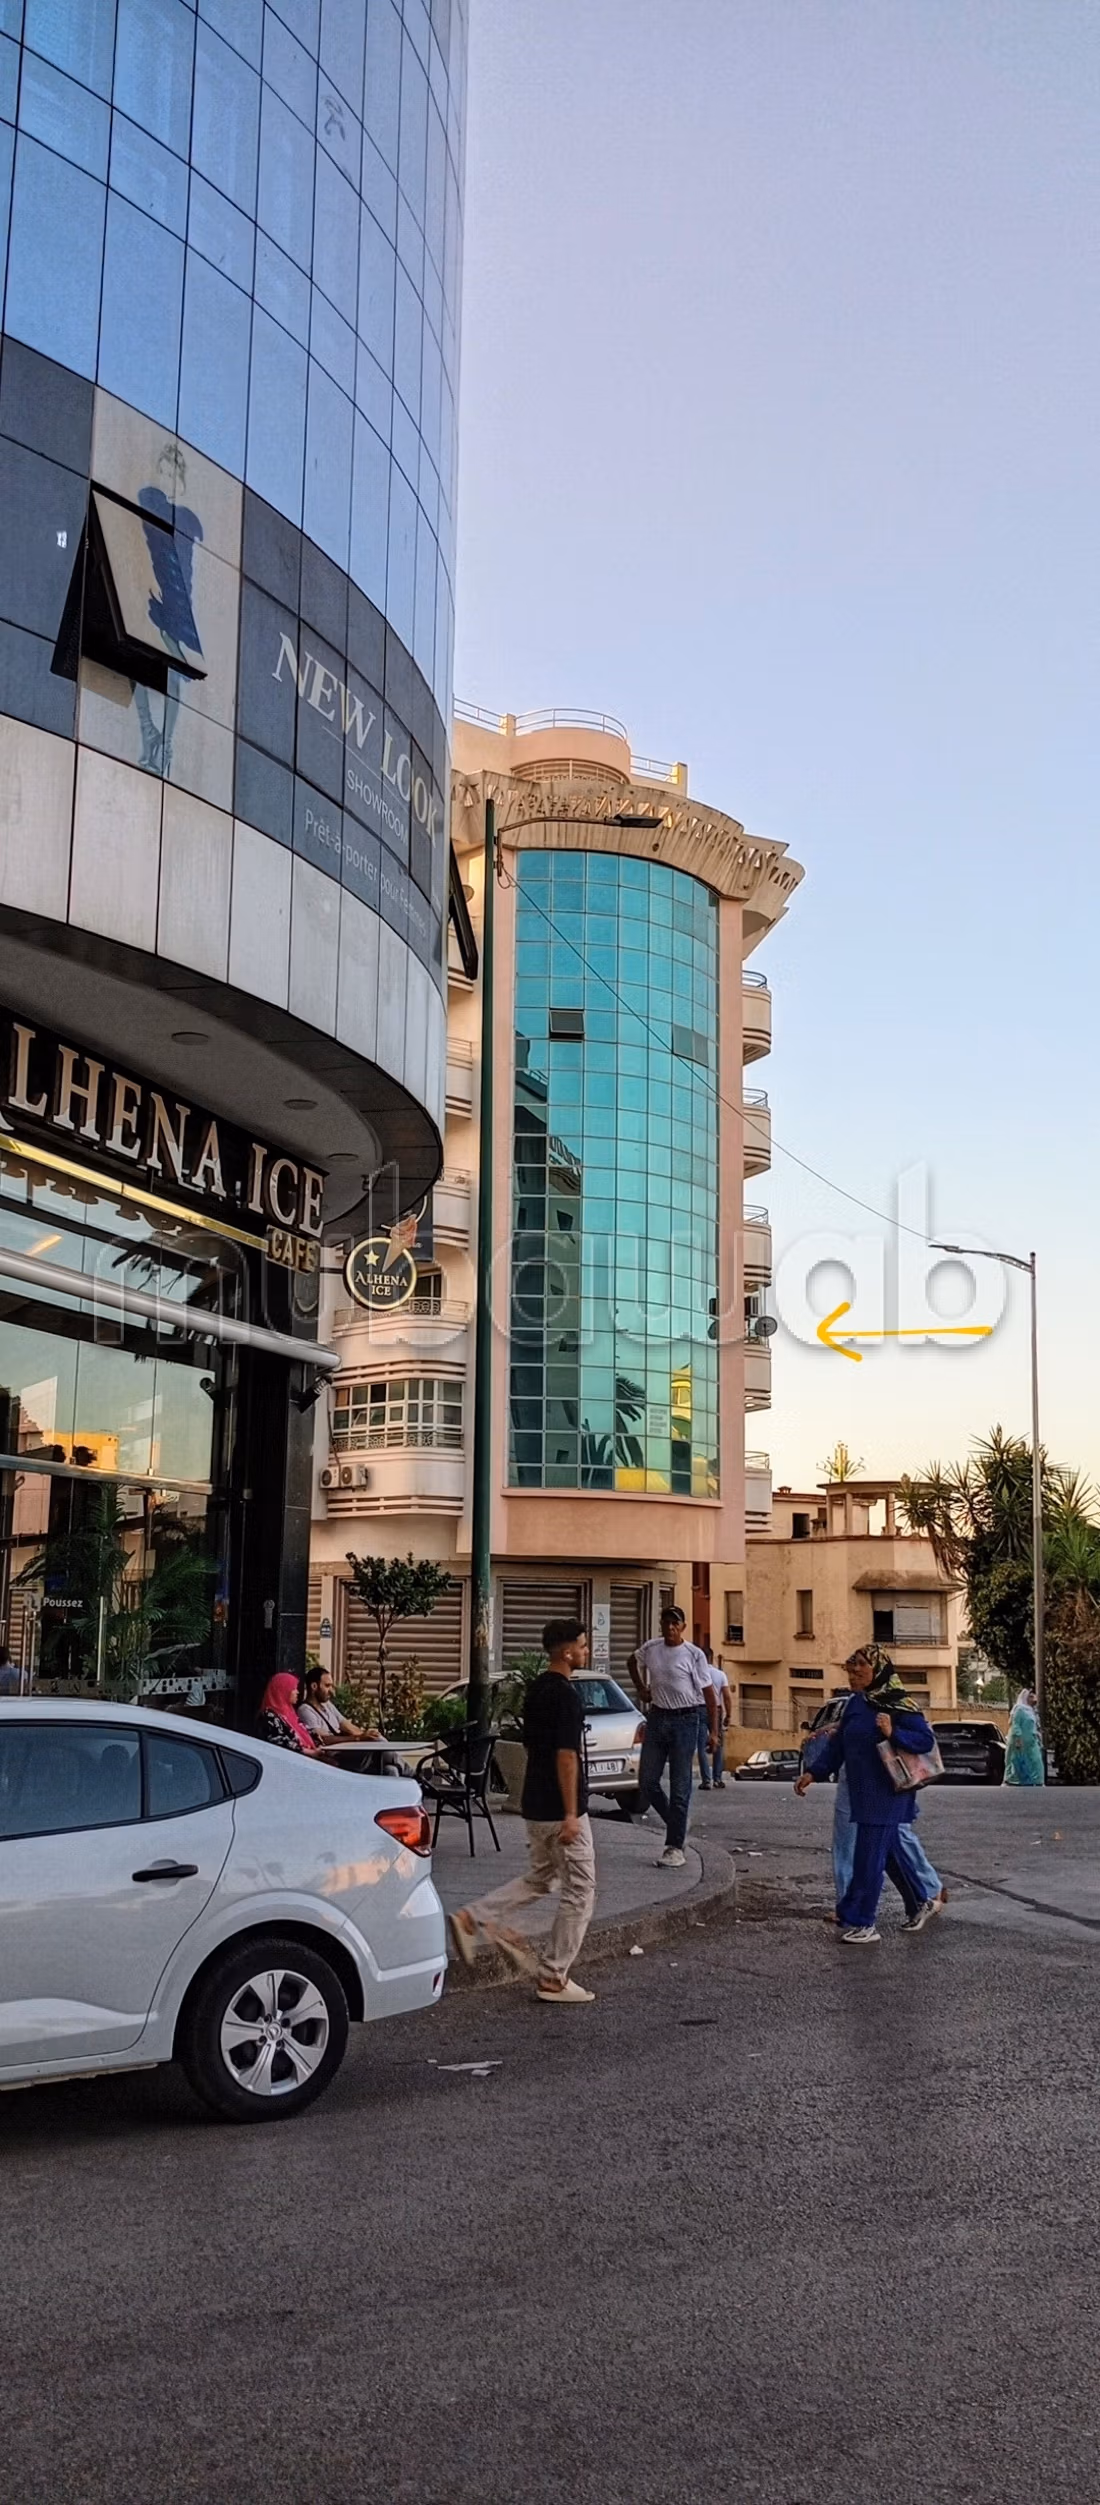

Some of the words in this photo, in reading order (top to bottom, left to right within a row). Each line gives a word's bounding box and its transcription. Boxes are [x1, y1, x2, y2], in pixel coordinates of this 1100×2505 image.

[272, 632, 376, 749] NEW
[381, 729, 437, 848] LOOK
[346, 769, 408, 846] SHOWROOM
[305, 809, 378, 881] Prêt-à-porter
[0, 1022, 226, 1198] LHENA
[248, 1143, 324, 1238] ICE
[355, 1270, 408, 1287] ALHENA
[371, 1285, 392, 1296] ICE
[43, 1597, 83, 1608] Poussez
